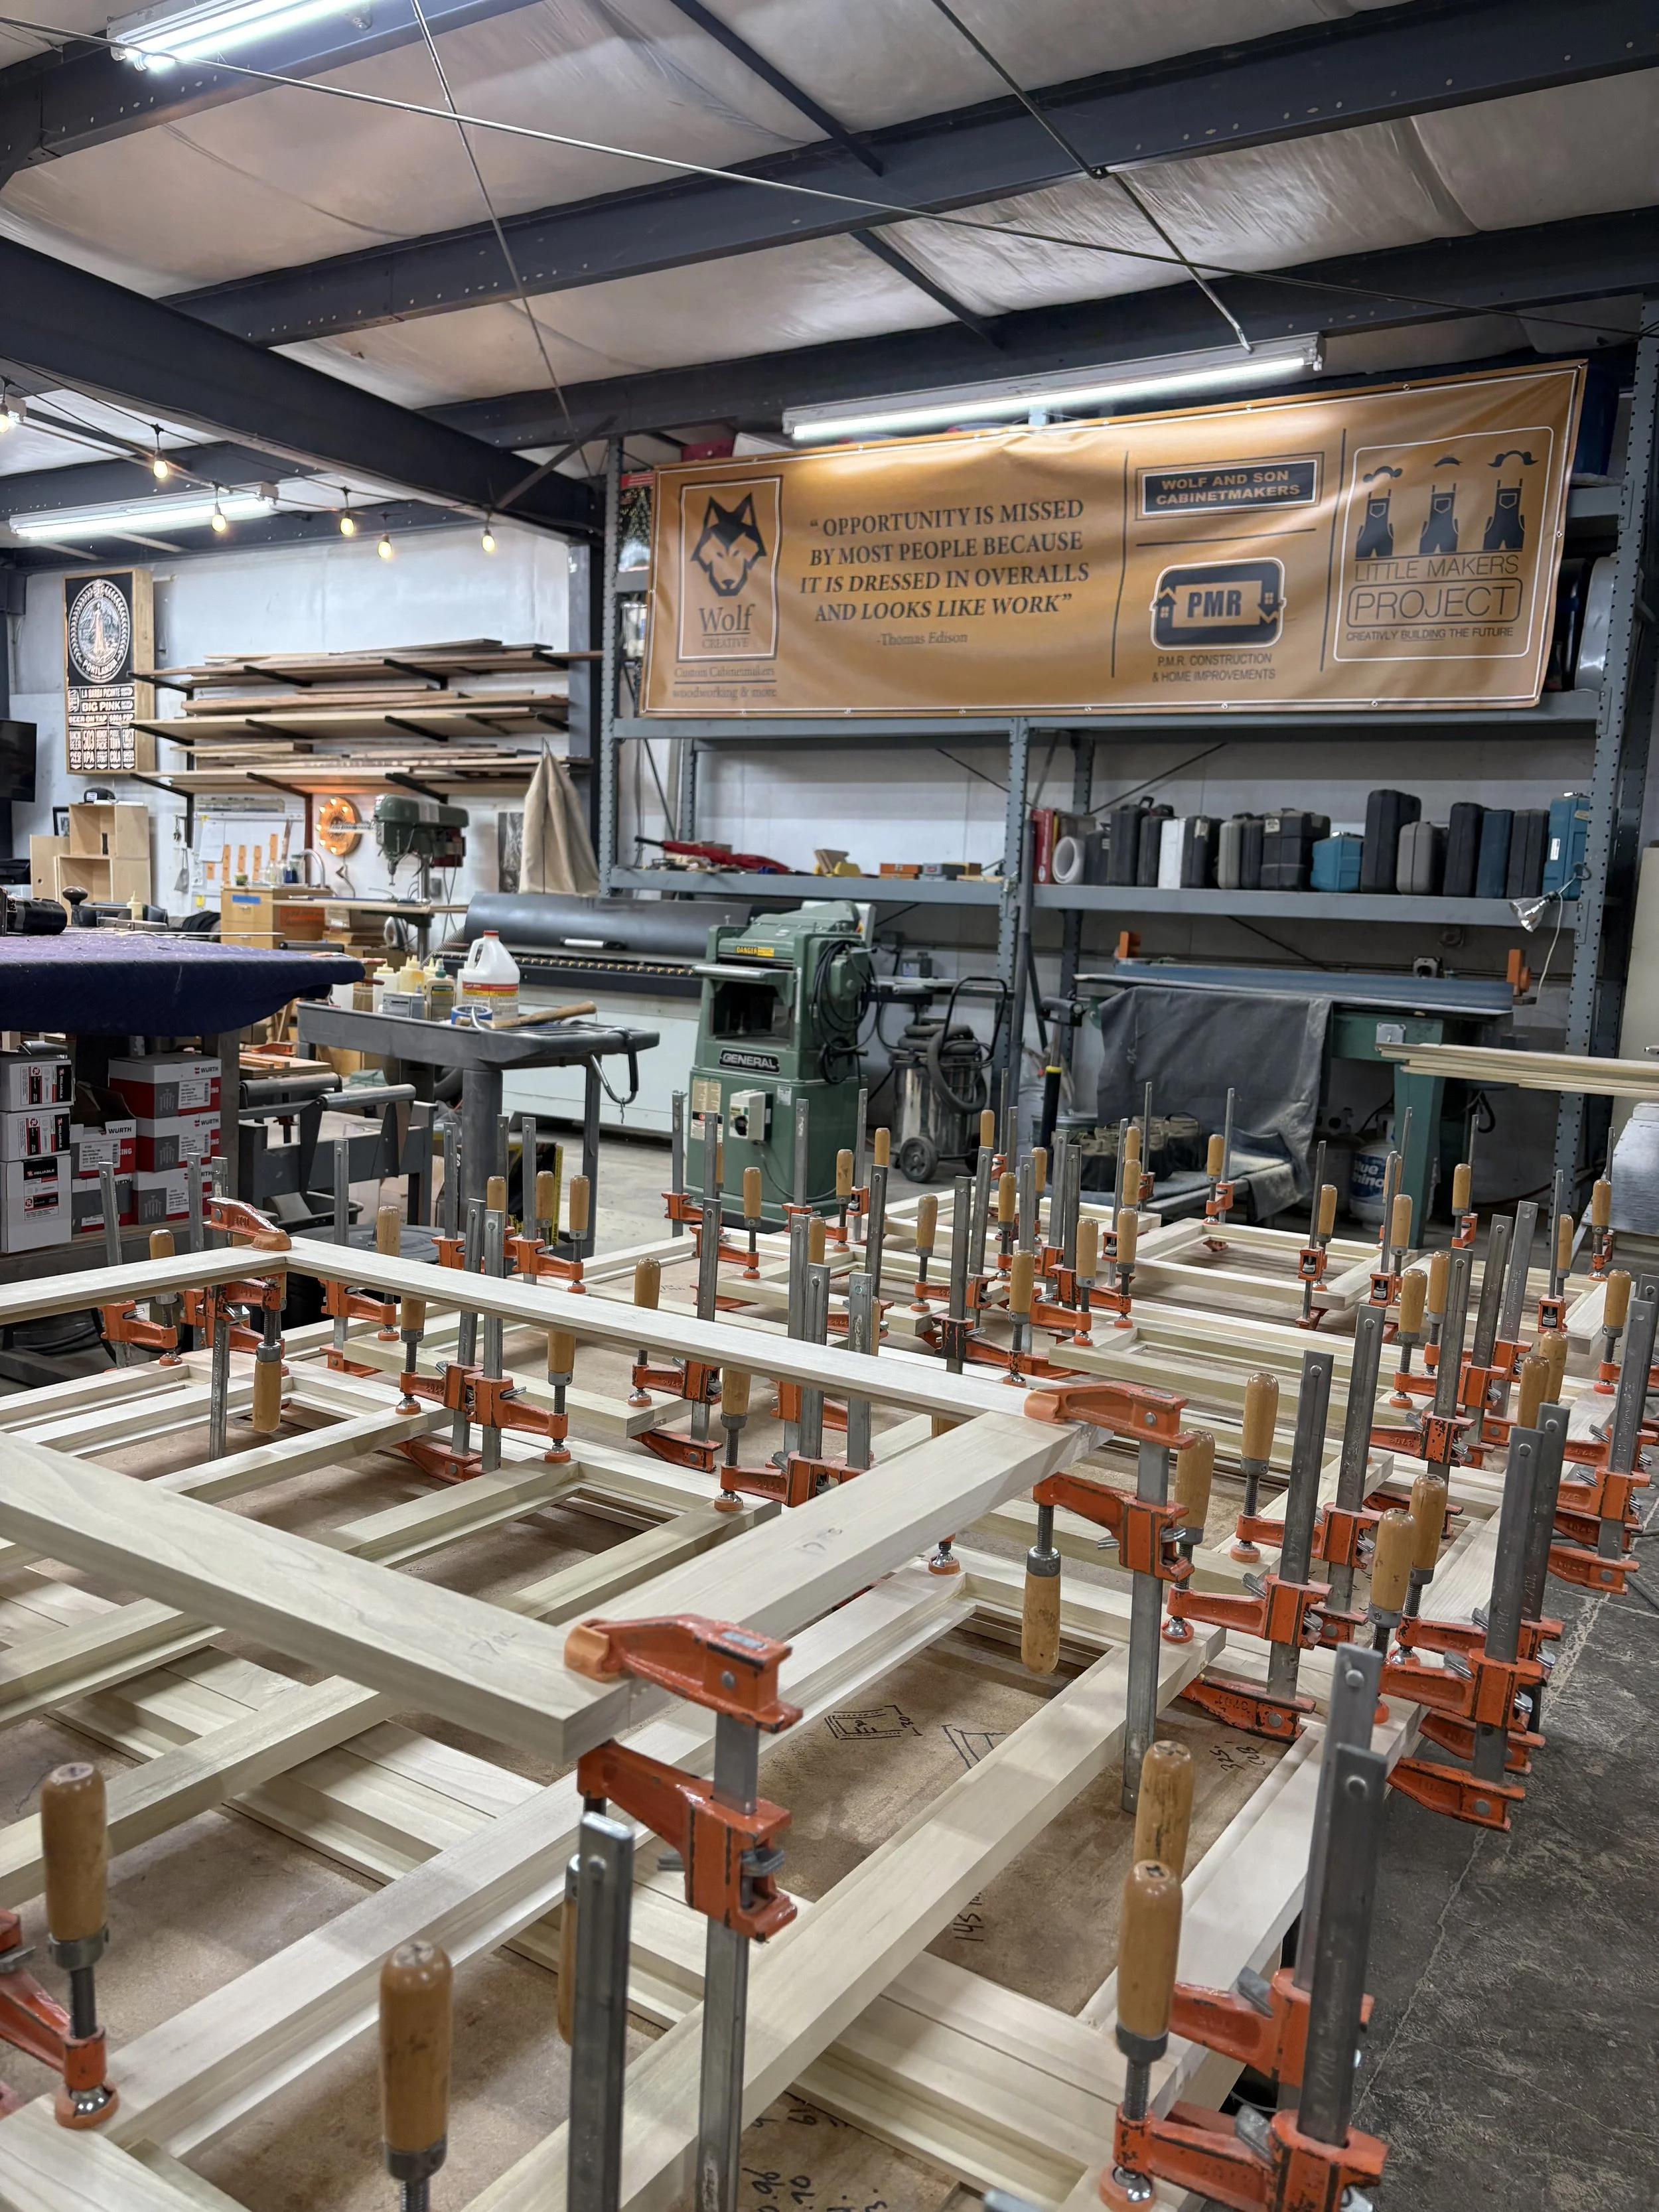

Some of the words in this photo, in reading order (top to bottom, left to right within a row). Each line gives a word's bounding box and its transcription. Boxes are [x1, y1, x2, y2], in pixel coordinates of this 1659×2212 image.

[1161, 477, 1208, 490] WOLF
[1212, 474, 1247, 486] AND
[1252, 469, 1289, 483] SON
[1155, 483, 1300, 505] CABINETMAKERS
[975, 505, 995, 526] IS
[998, 498, 1084, 523] MISSED
[810, 548, 836, 566] BY
[839, 544, 893, 565] MOST
[899, 538, 978, 560] PEOPLE
[983, 532, 1082, 555] BECAUSE
[1354, 560, 1419, 581] LITTLE
[1426, 555, 1519, 578] MAKERS
[800, 577, 822, 594] IT
[826, 575, 843, 593] IS
[848, 570, 941, 592] DRESSED
[946, 568, 968, 588] IN
[974, 562, 1090, 587] OVERALLS
[814, 603, 856, 622] AND
[861, 601, 932, 620] LOOKS
[935, 599, 985, 617] LIKE
[1187, 589, 1242, 618] PMR
[1354, 585, 1516, 621] PROJECT
[699, 604, 756, 633] Wolf
[702, 638, 749, 648] CREATIVE
[928, 630, 968, 644] Edison
[1346, 629, 1398, 641] CREATIVLY
[1400, 628, 1446, 640] BUILDING
[1449, 628, 1470, 639] THE
[1472, 627, 1514, 638] FUTURE
[1190, 652, 1272, 666] CONSTRUCTION
[674, 668, 707, 678] Custom
[1152, 671, 1159, 682] &
[1162, 670, 1192, 682] HOME
[1195, 668, 1276, 681] IMPROVEMENTS
[751, 688, 776, 698] more
[82, 702, 98, 711] BIG
[100, 701, 121, 711] PINK
[84, 751, 94, 763] IPA
[723, 1053, 776, 1069] GENERAL
